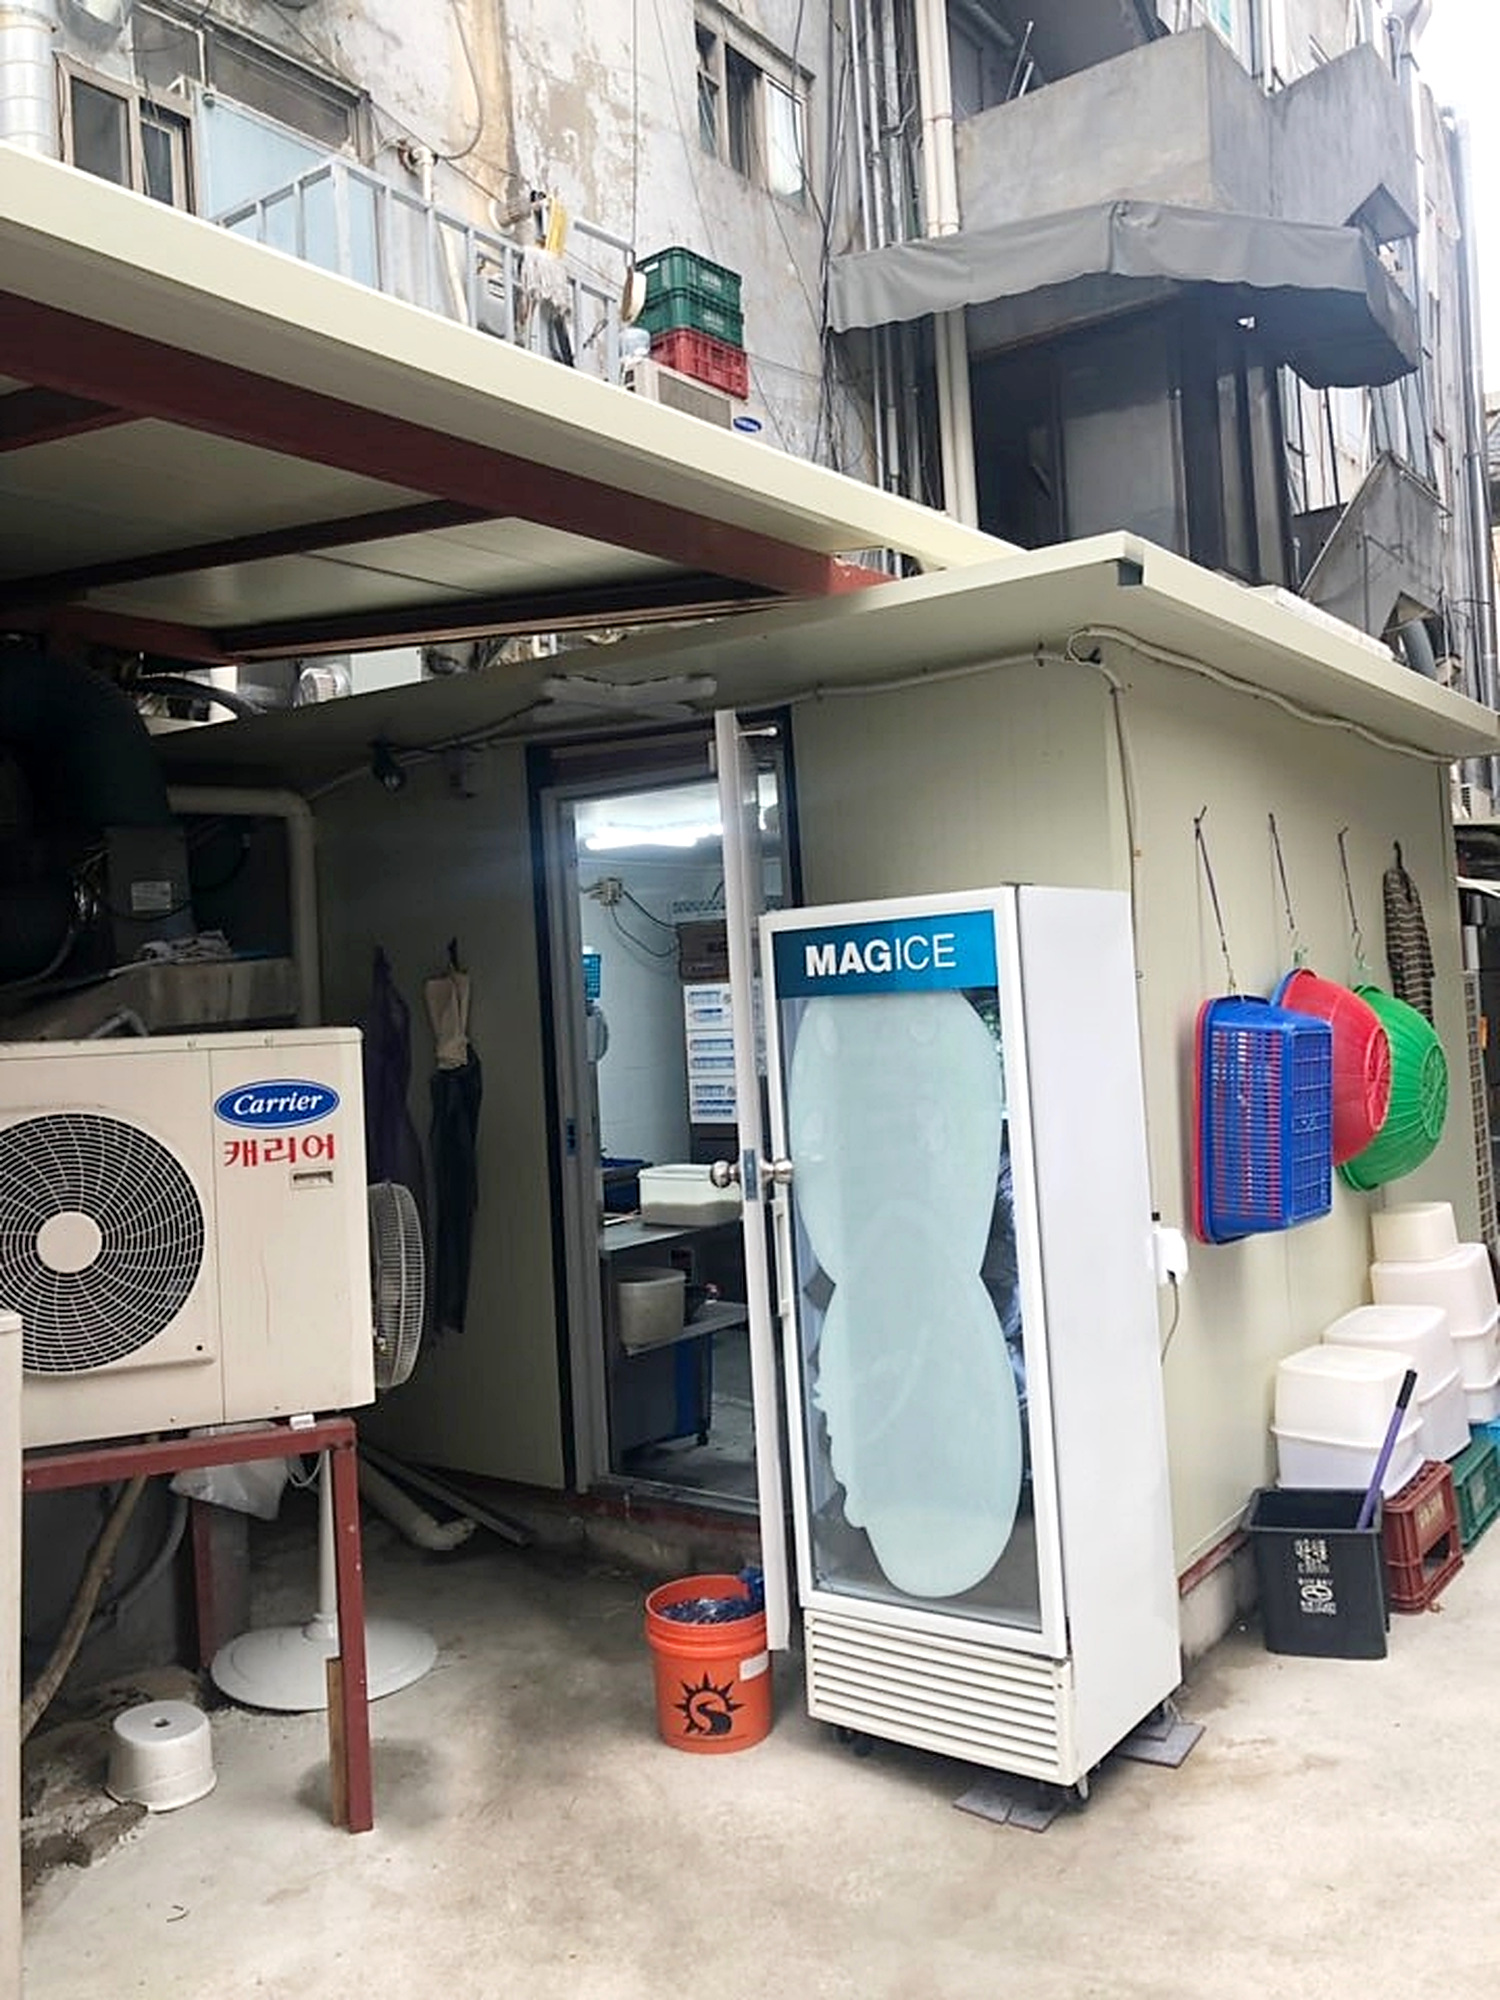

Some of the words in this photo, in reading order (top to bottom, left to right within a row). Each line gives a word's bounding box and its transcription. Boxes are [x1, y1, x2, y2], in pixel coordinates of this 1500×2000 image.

[805, 933, 957, 977] MAGICE
[233, 1091, 323, 1115] Carrier
[223, 1133, 334, 1167] 캐리어
